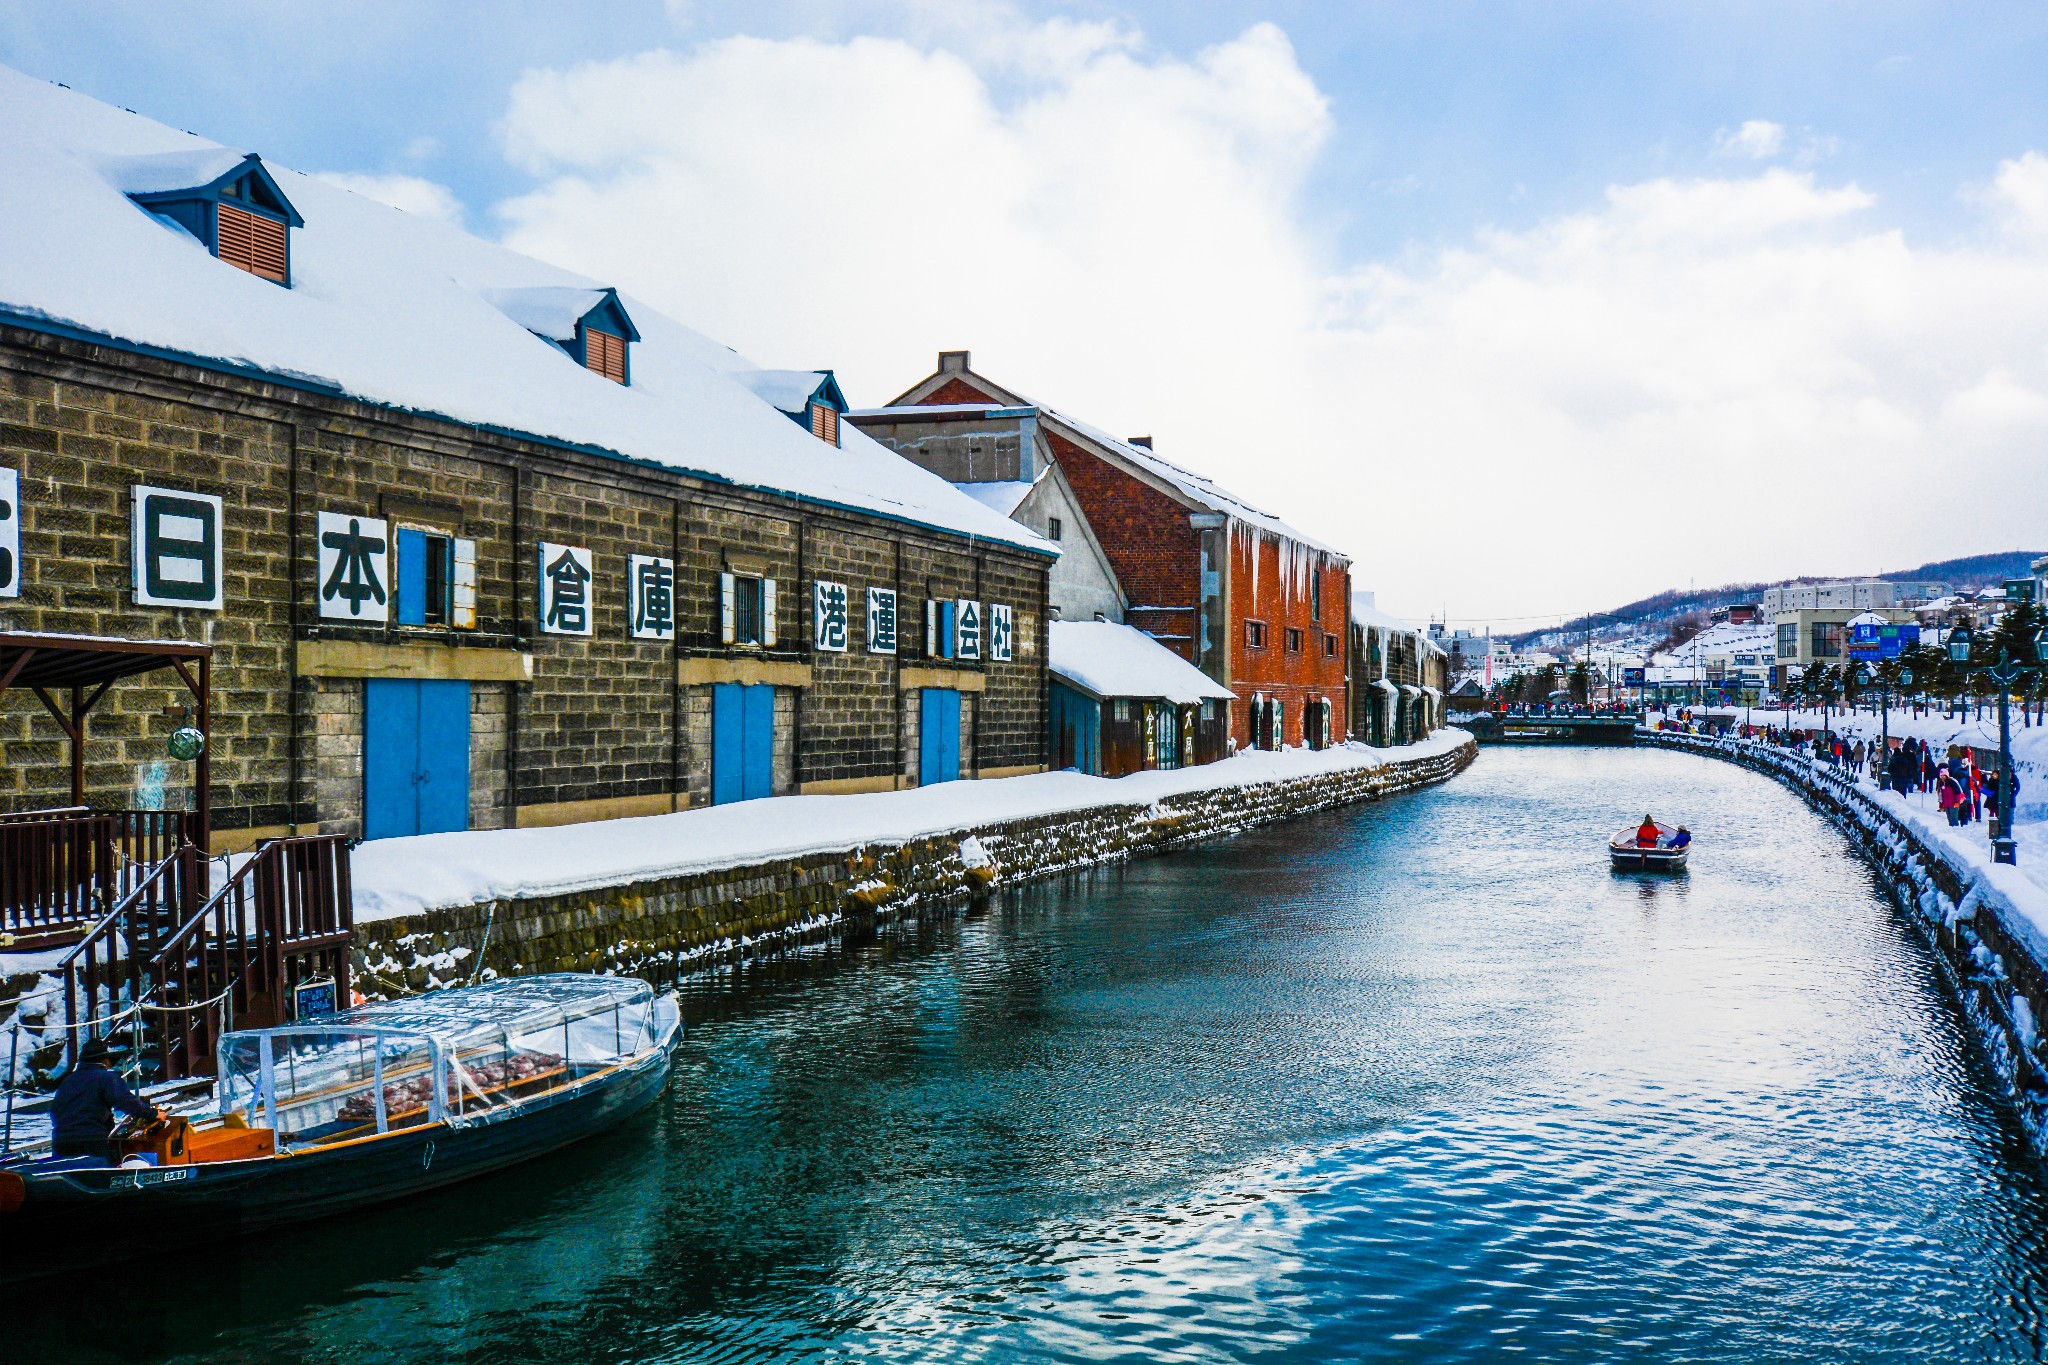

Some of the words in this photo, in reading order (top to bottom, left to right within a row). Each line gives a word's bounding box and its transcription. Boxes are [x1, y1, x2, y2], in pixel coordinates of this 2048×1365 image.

[145, 494, 216, 601] 日
[321, 518, 386, 616] 本
[546, 548, 591, 632] 倉
[636, 558, 673, 636] 庫
[819, 585, 846, 648] 港
[872, 591, 896, 650] 運
[960, 601, 979, 657] 会
[993, 609, 1011, 658] 社
